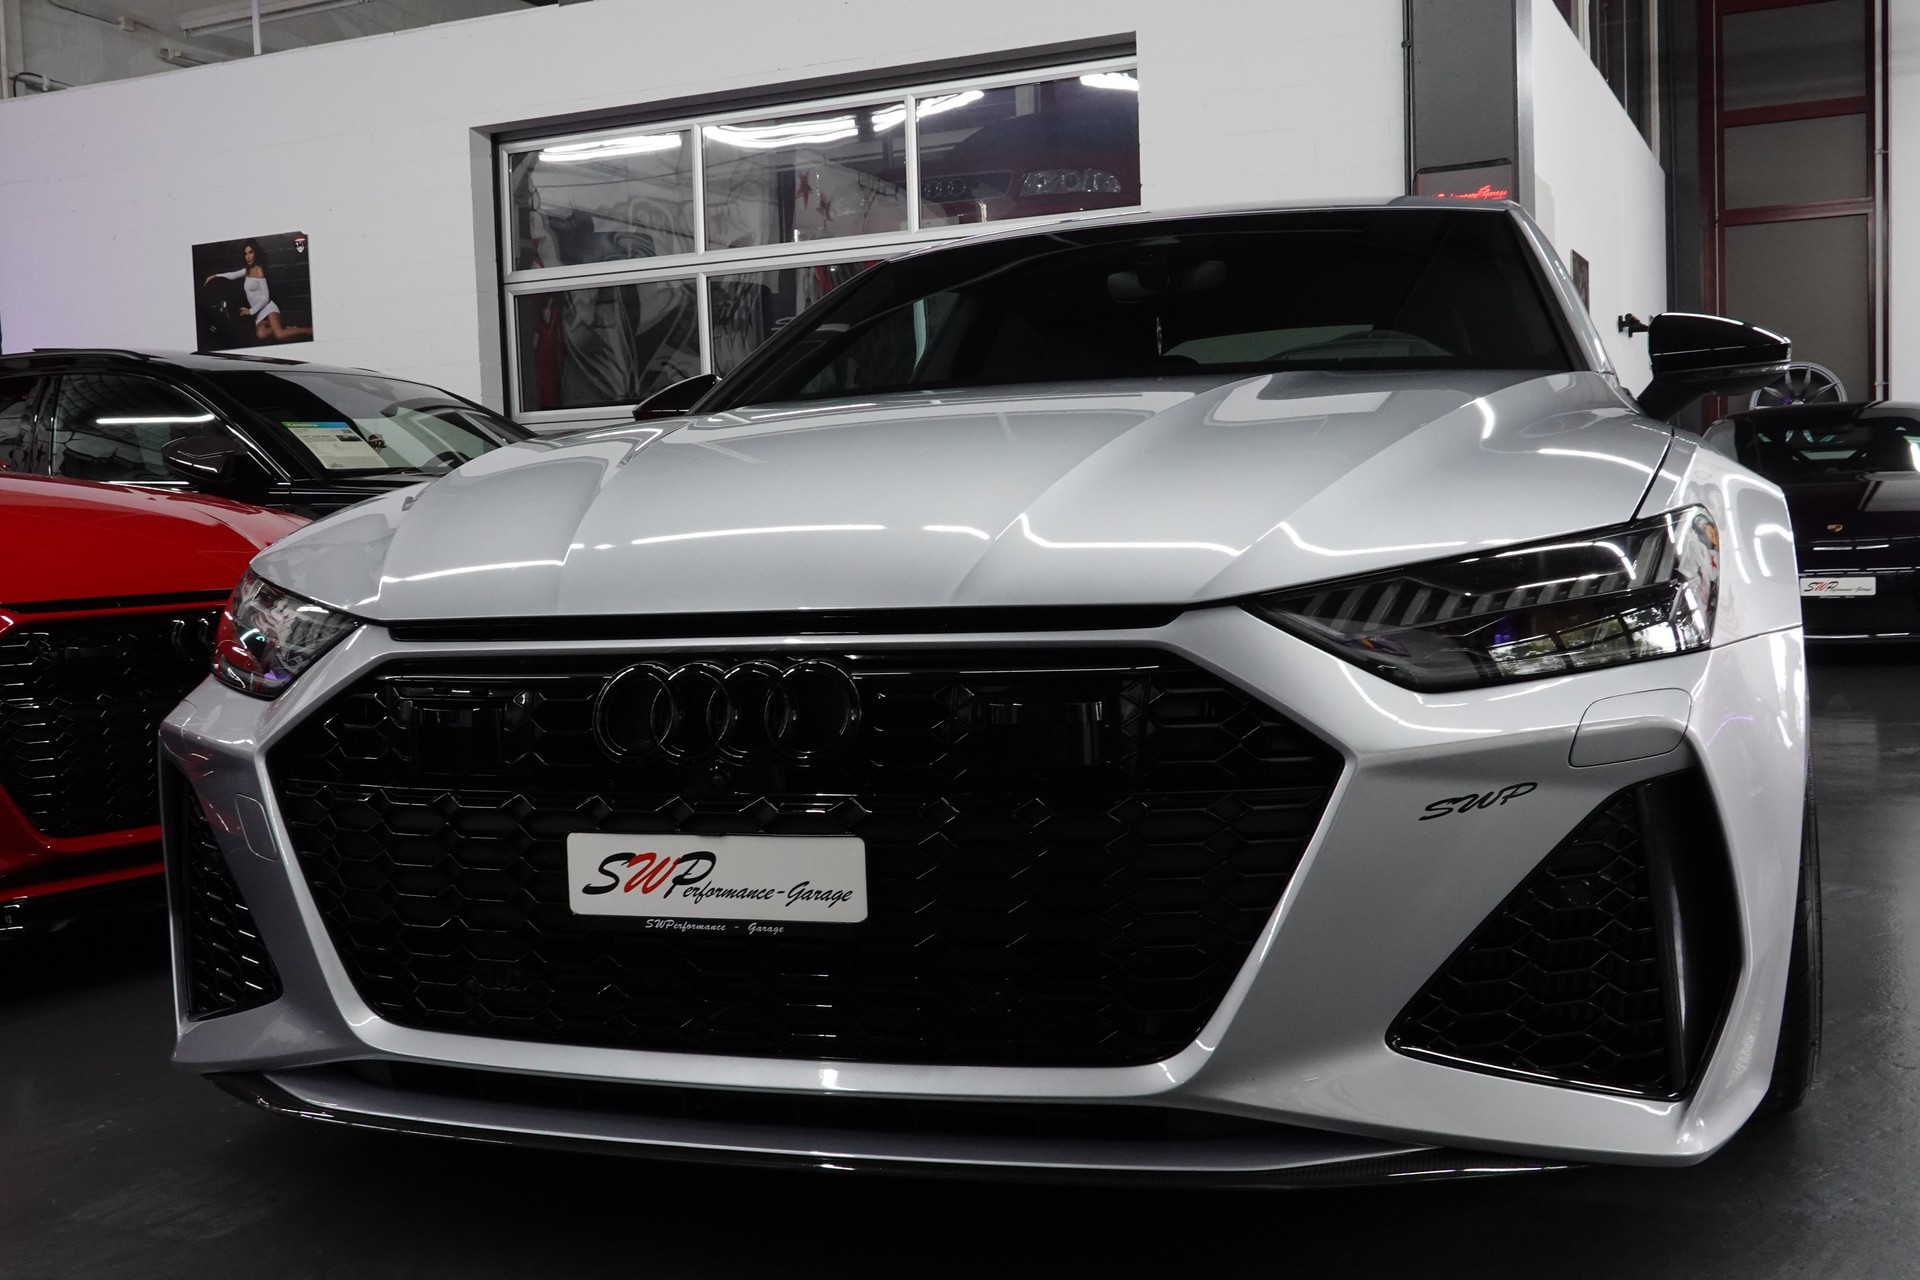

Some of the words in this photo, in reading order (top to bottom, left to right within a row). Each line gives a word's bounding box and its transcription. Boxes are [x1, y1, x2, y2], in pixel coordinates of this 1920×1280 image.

[1418, 782, 1538, 821] SWP
[645, 919, 726, 932] SWPerformance
[748, 922, 784, 935] Garage
